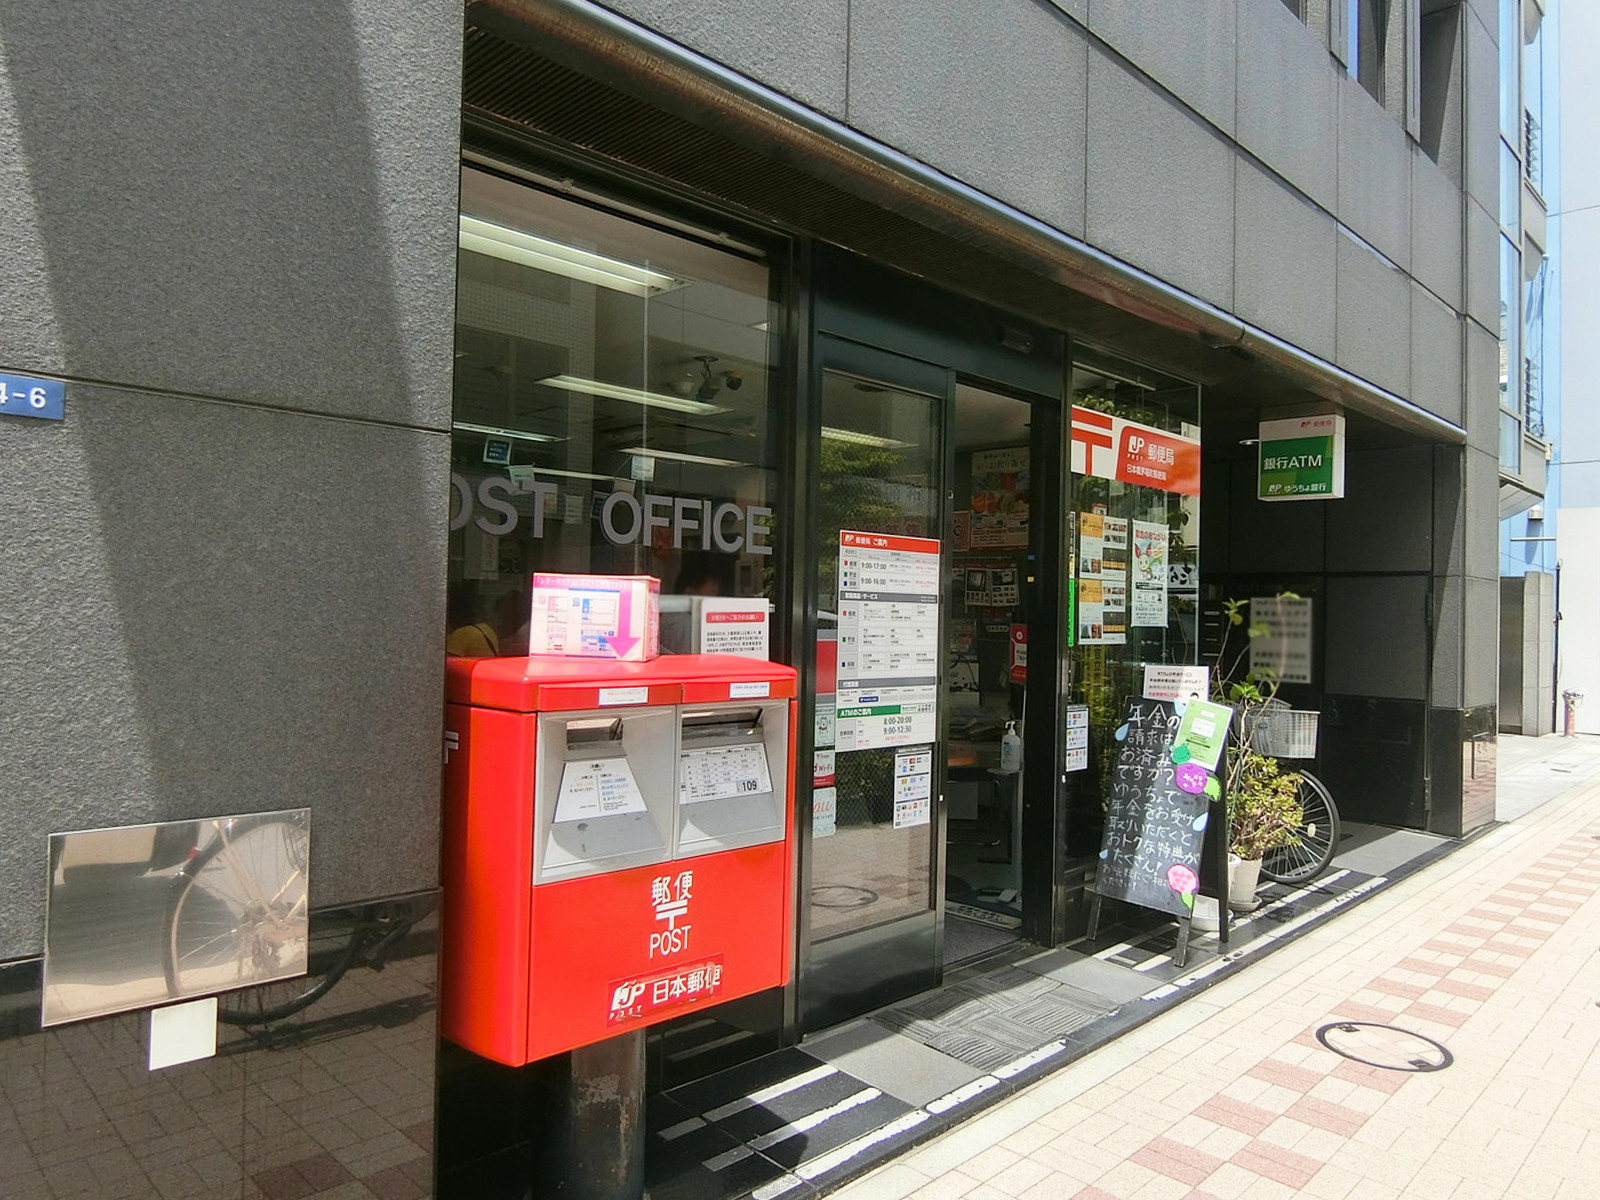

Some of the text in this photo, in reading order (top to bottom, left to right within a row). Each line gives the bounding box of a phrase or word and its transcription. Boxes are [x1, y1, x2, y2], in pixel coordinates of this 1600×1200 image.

[1147, 443, 1175, 466] 郵便局
[1263, 454, 1322, 471] 銀行ATM
[1283, 482, 1327, 493] ゆうちょ銀行
[601, 490, 773, 556] OFFICE
[861, 562, 887, 570] 9:00-17:00
[860, 577, 887, 586] 9:00-16:00
[883, 716, 912, 725] 8:00-20:00
[1128, 703, 1180, 729] 年金の
[883, 725, 912, 735] 9:00-12:30
[1127, 728, 1174, 745] 請求は
[1121, 745, 1172, 767] お済み
[742, 780, 757, 792] 109
[1117, 764, 1174, 785] ですか?
[1113, 782, 1182, 805] ゆうちょで
[1111, 798, 1195, 827] 年金をお受け
[1108, 815, 1193, 847] 取りいただくと
[1106, 831, 1200, 865] おトクな特典が
[1113, 847, 1163, 876] たくさん!
[651, 871, 693, 906] 郵便
[649, 925, 692, 959] POST
[652, 964, 723, 1005] 日本郵便
